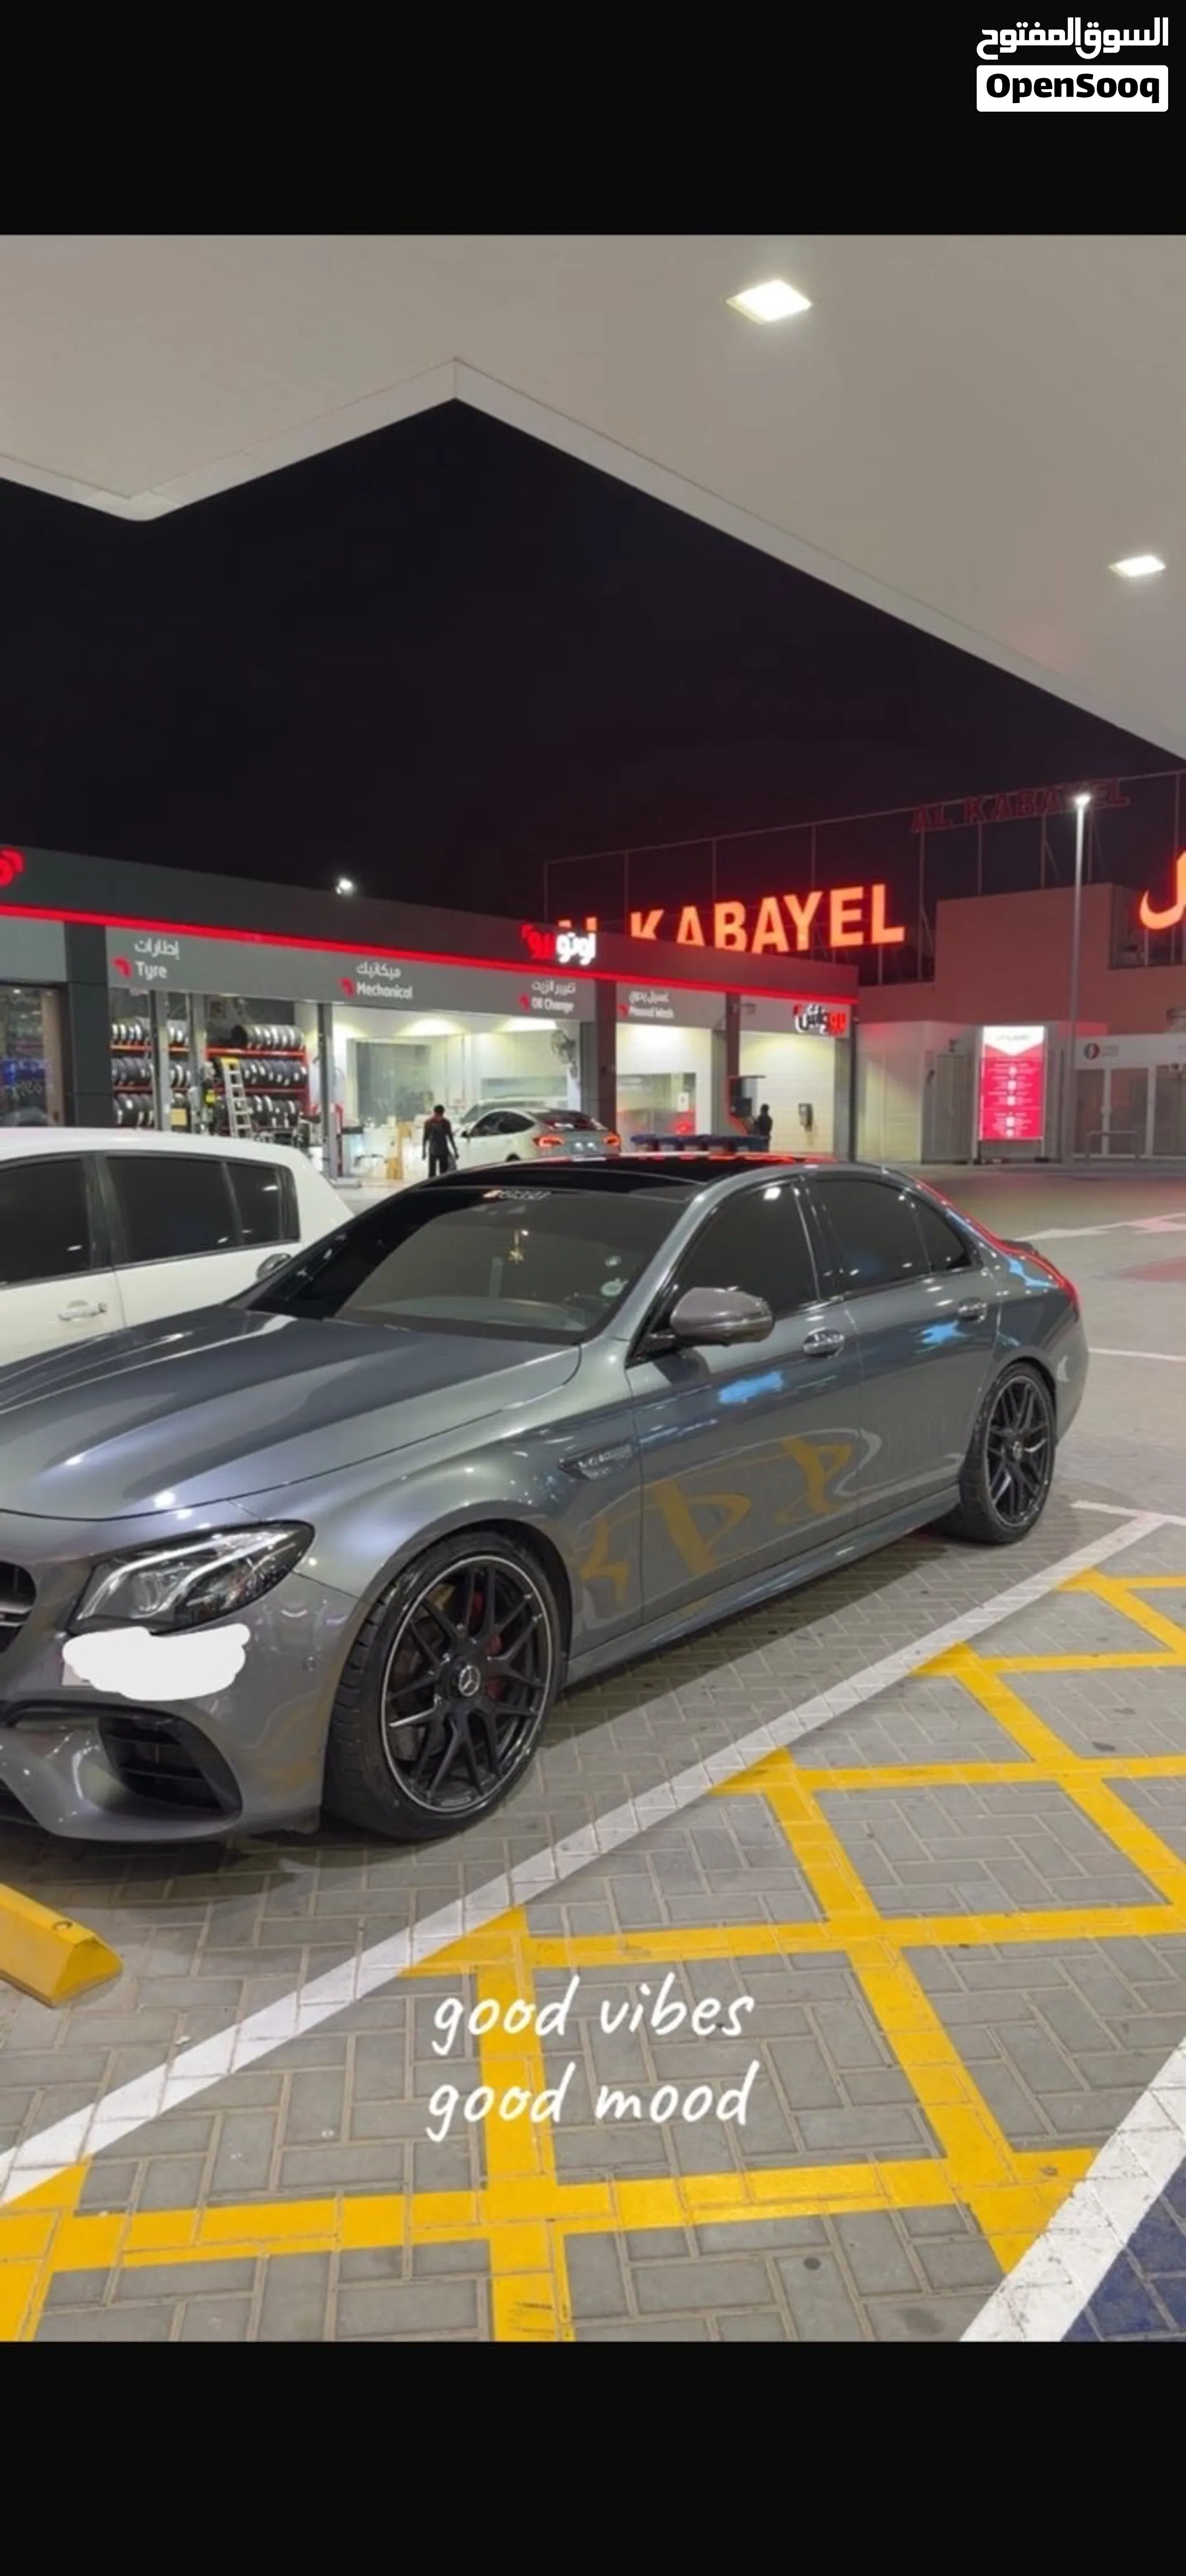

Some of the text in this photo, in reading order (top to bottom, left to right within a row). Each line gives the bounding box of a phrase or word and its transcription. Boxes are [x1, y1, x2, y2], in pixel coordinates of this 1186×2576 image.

[630, 884, 905, 955] KABAYEL
[134, 960, 168, 981] Tyre
[356, 981, 414, 1000] Mechanical
